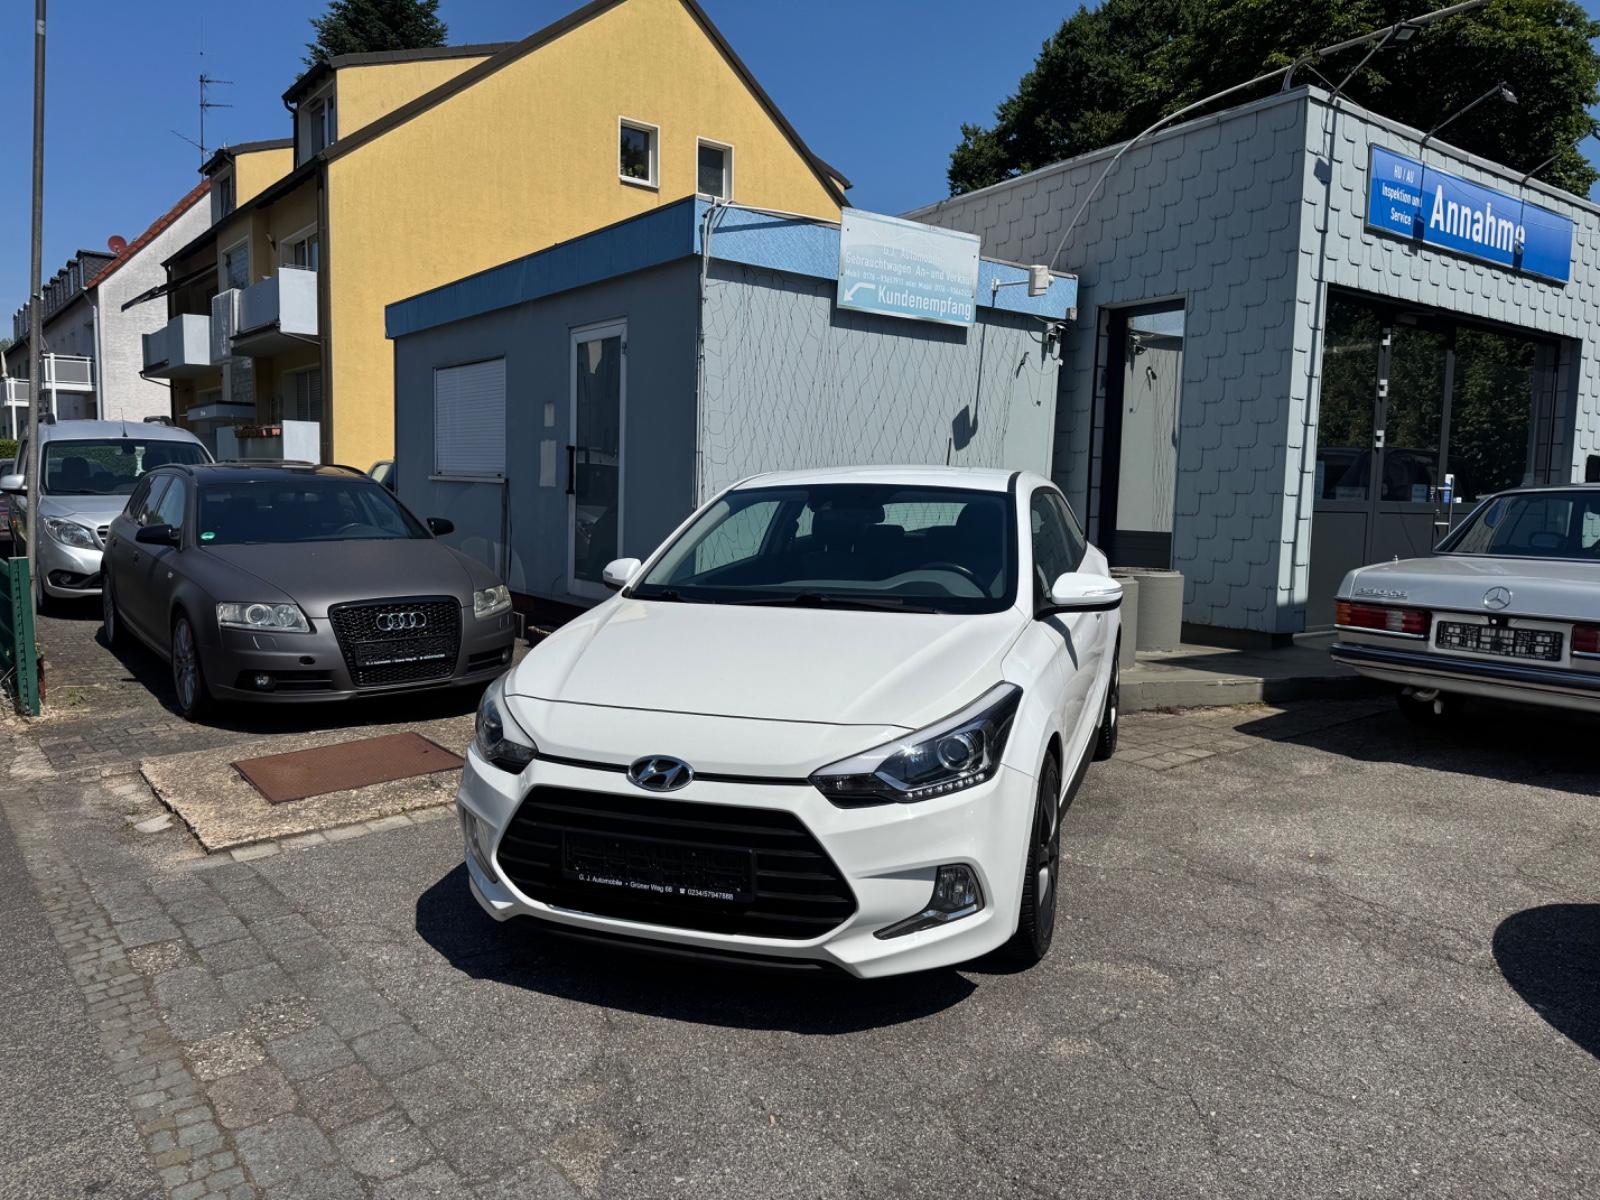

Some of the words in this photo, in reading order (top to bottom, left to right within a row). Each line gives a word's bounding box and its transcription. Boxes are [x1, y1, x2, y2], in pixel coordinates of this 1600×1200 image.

[1382, 182, 1412, 205] Inspektion
[1390, 207, 1412, 225] Service
[1429, 184, 1526, 255] Annahme
[878, 285, 972, 321] Kundenempfang
[592, 875, 623, 887] Automobile
[650, 883, 664, 893] Weg
